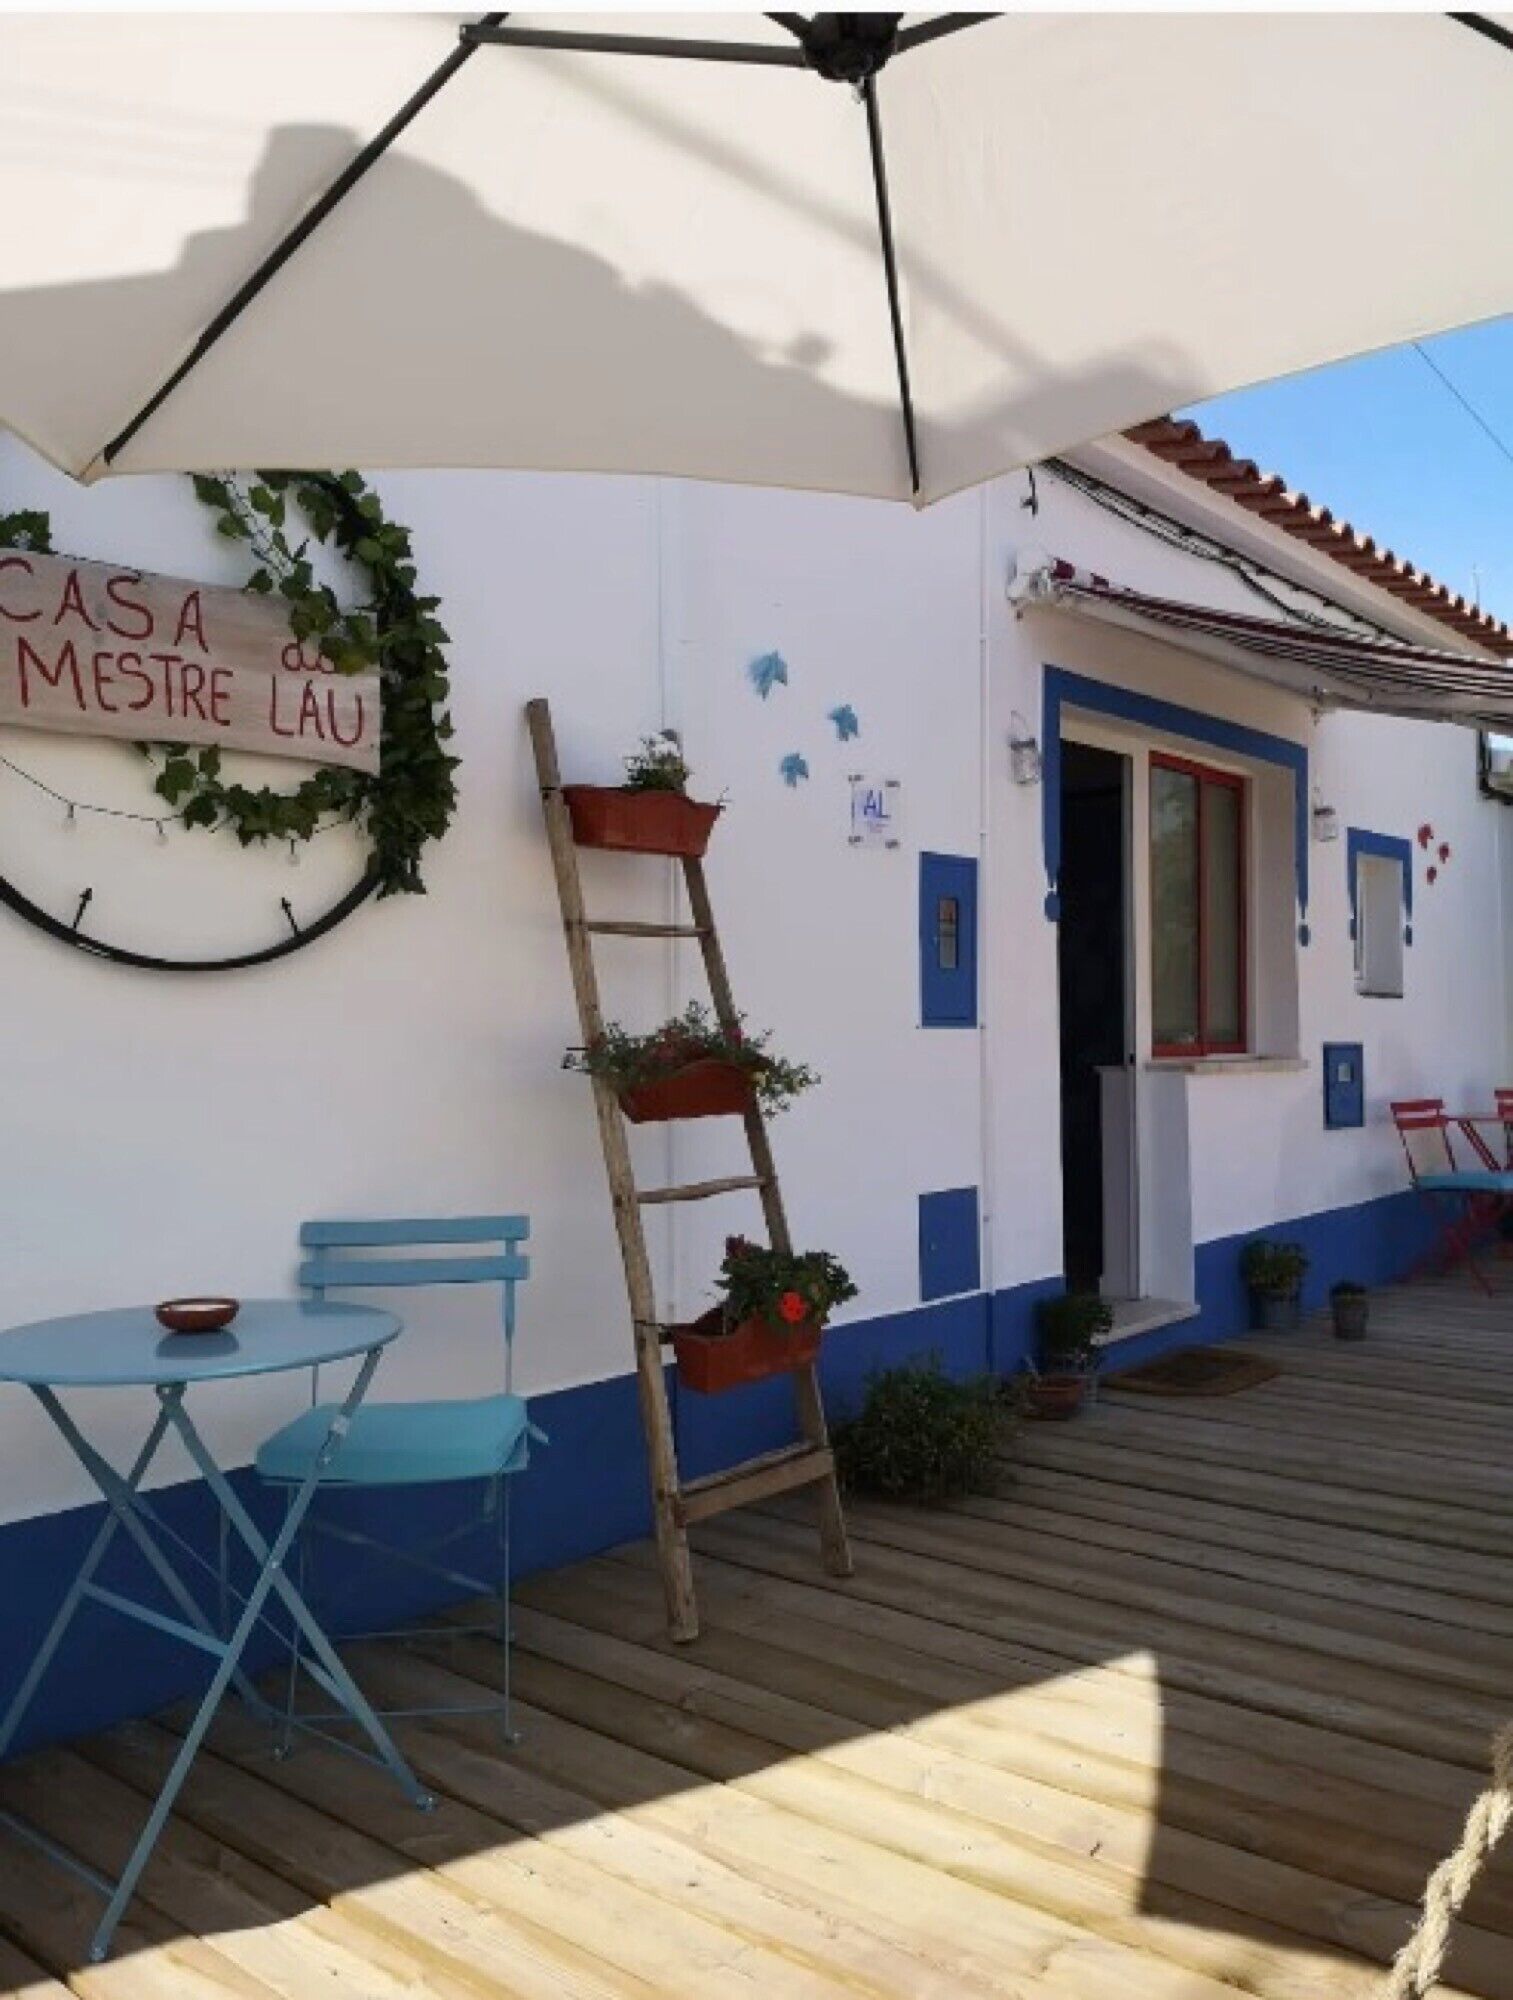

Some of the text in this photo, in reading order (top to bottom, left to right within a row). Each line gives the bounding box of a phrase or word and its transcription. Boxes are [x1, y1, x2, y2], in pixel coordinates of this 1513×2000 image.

[0, 556, 209, 654] CASA
[18, 635, 234, 727] MESTRE
[863, 789, 891, 819] AL
